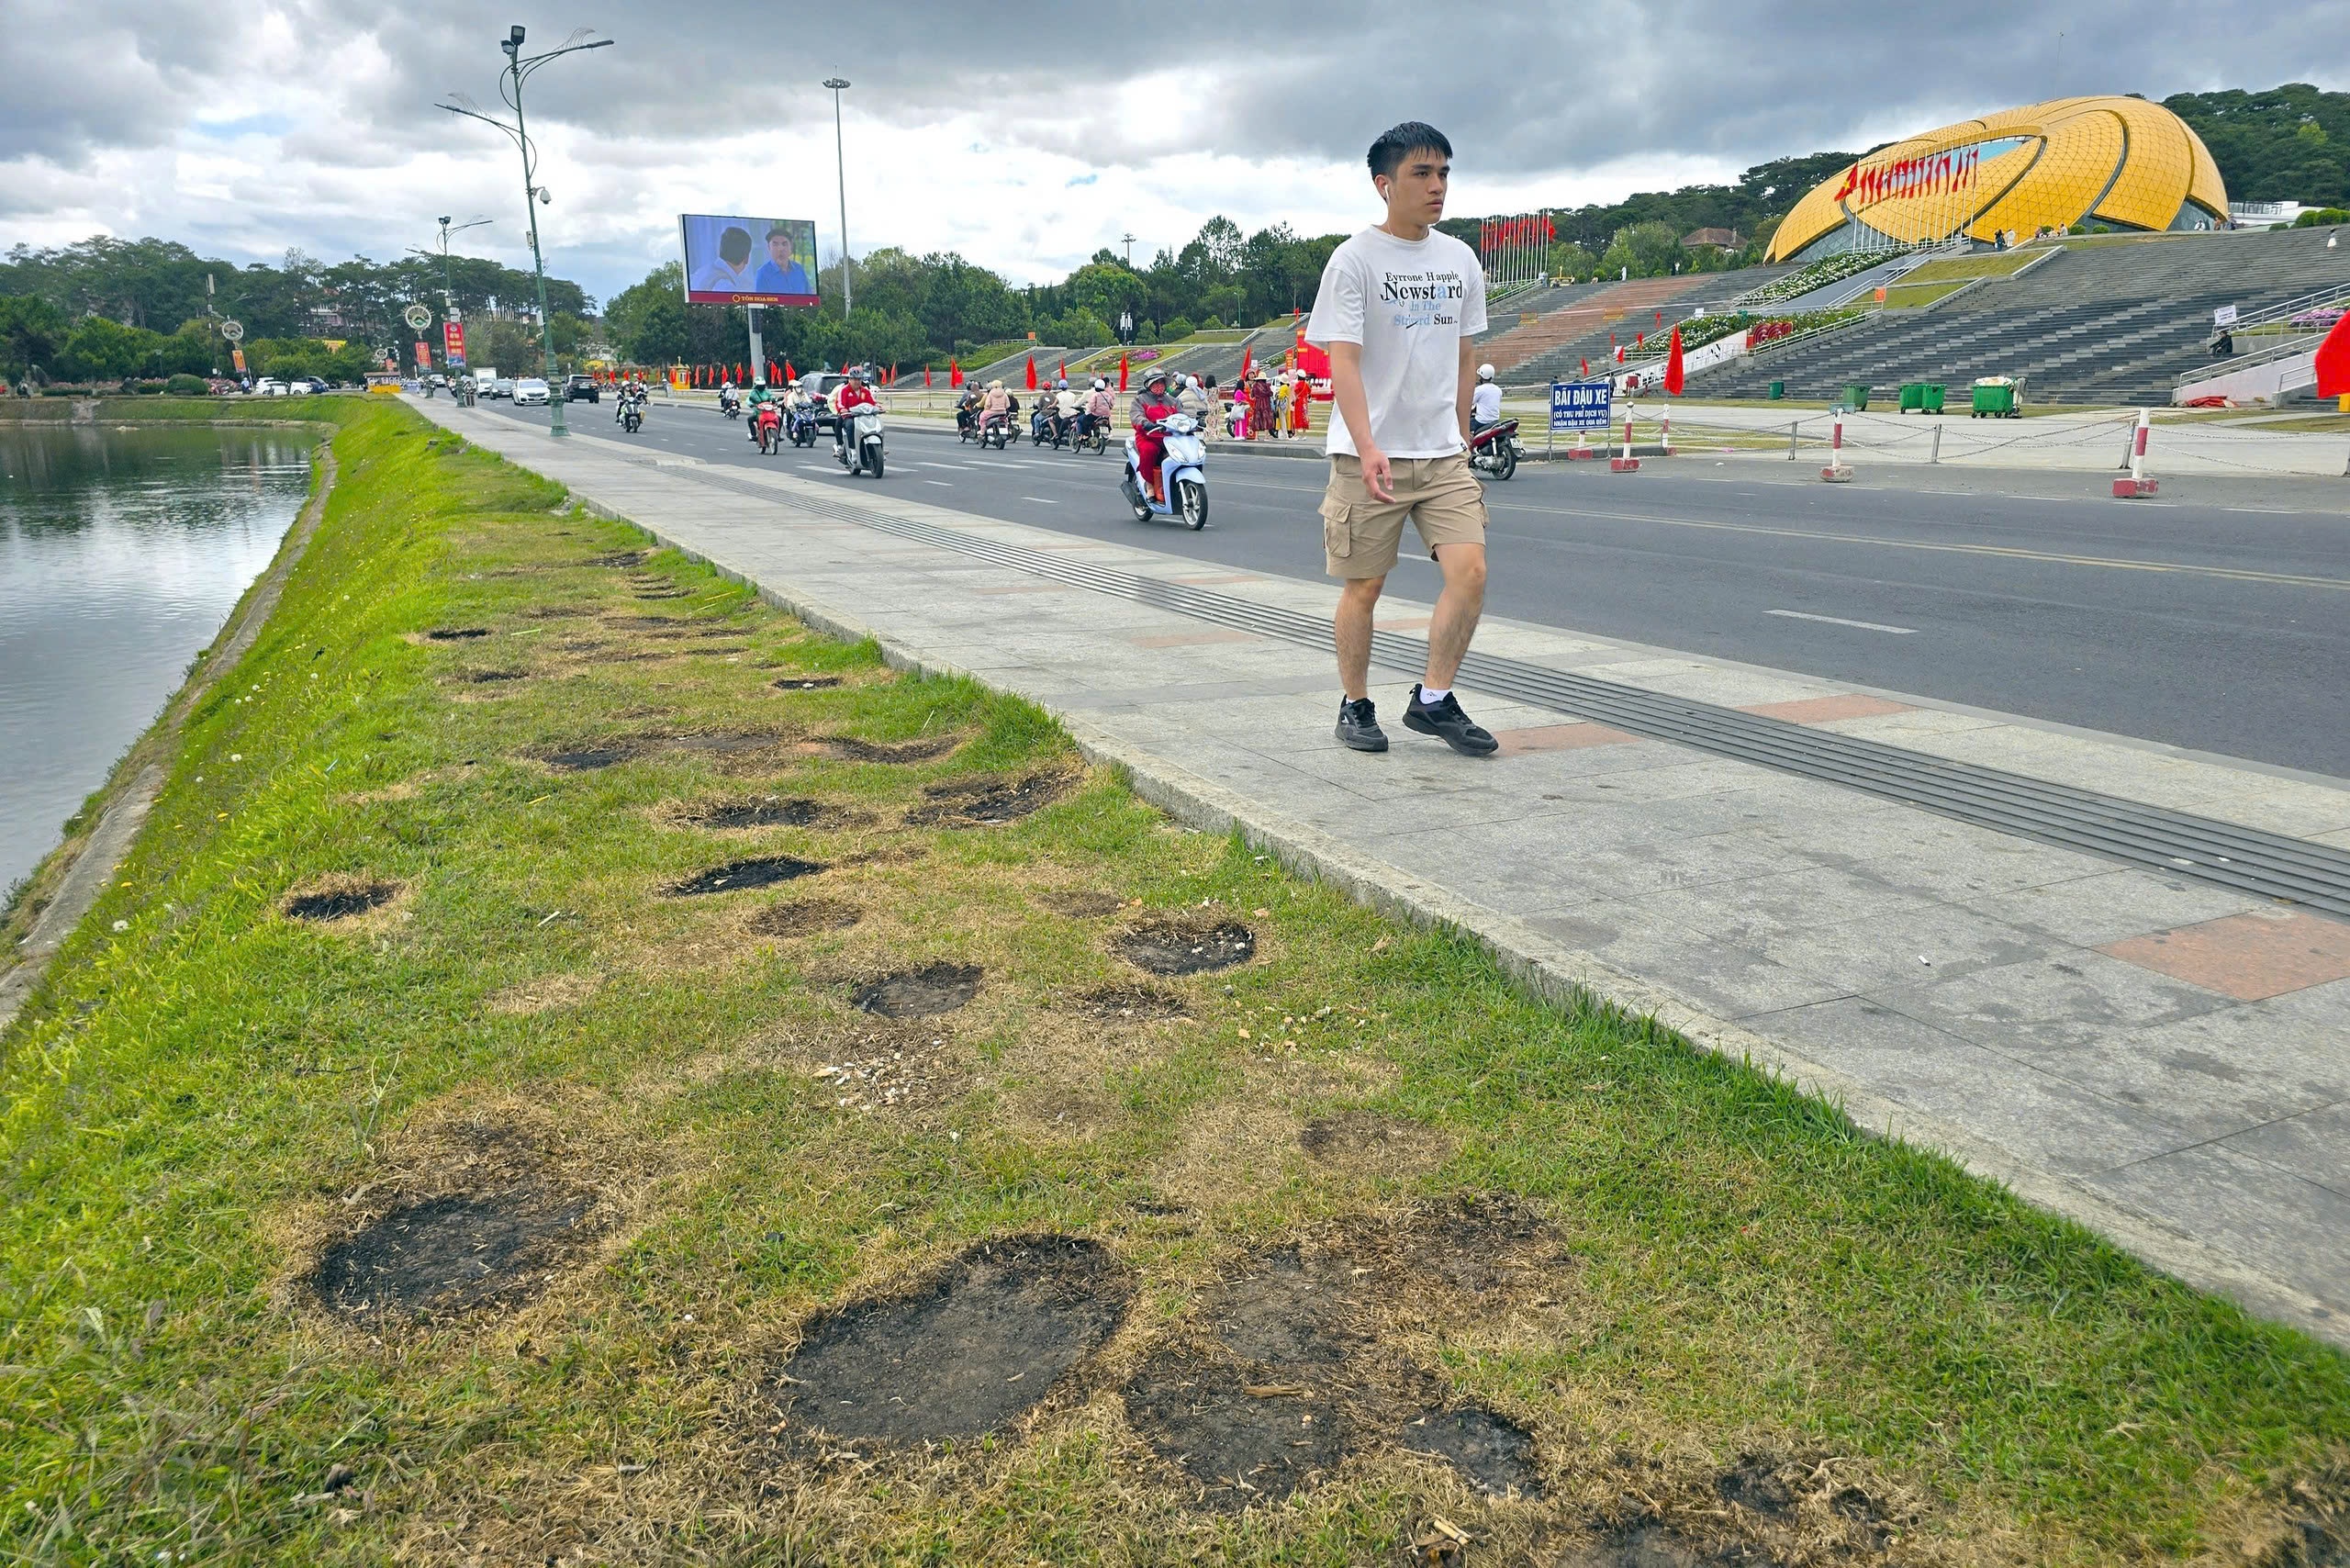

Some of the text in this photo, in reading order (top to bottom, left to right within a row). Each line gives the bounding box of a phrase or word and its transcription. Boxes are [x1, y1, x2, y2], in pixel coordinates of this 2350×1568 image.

[1554, 386, 1607, 408] BÃI ĐẬU XE
[1574, 409, 1584, 418] PHÍ
[1584, 409, 1596, 419] DỊCH
